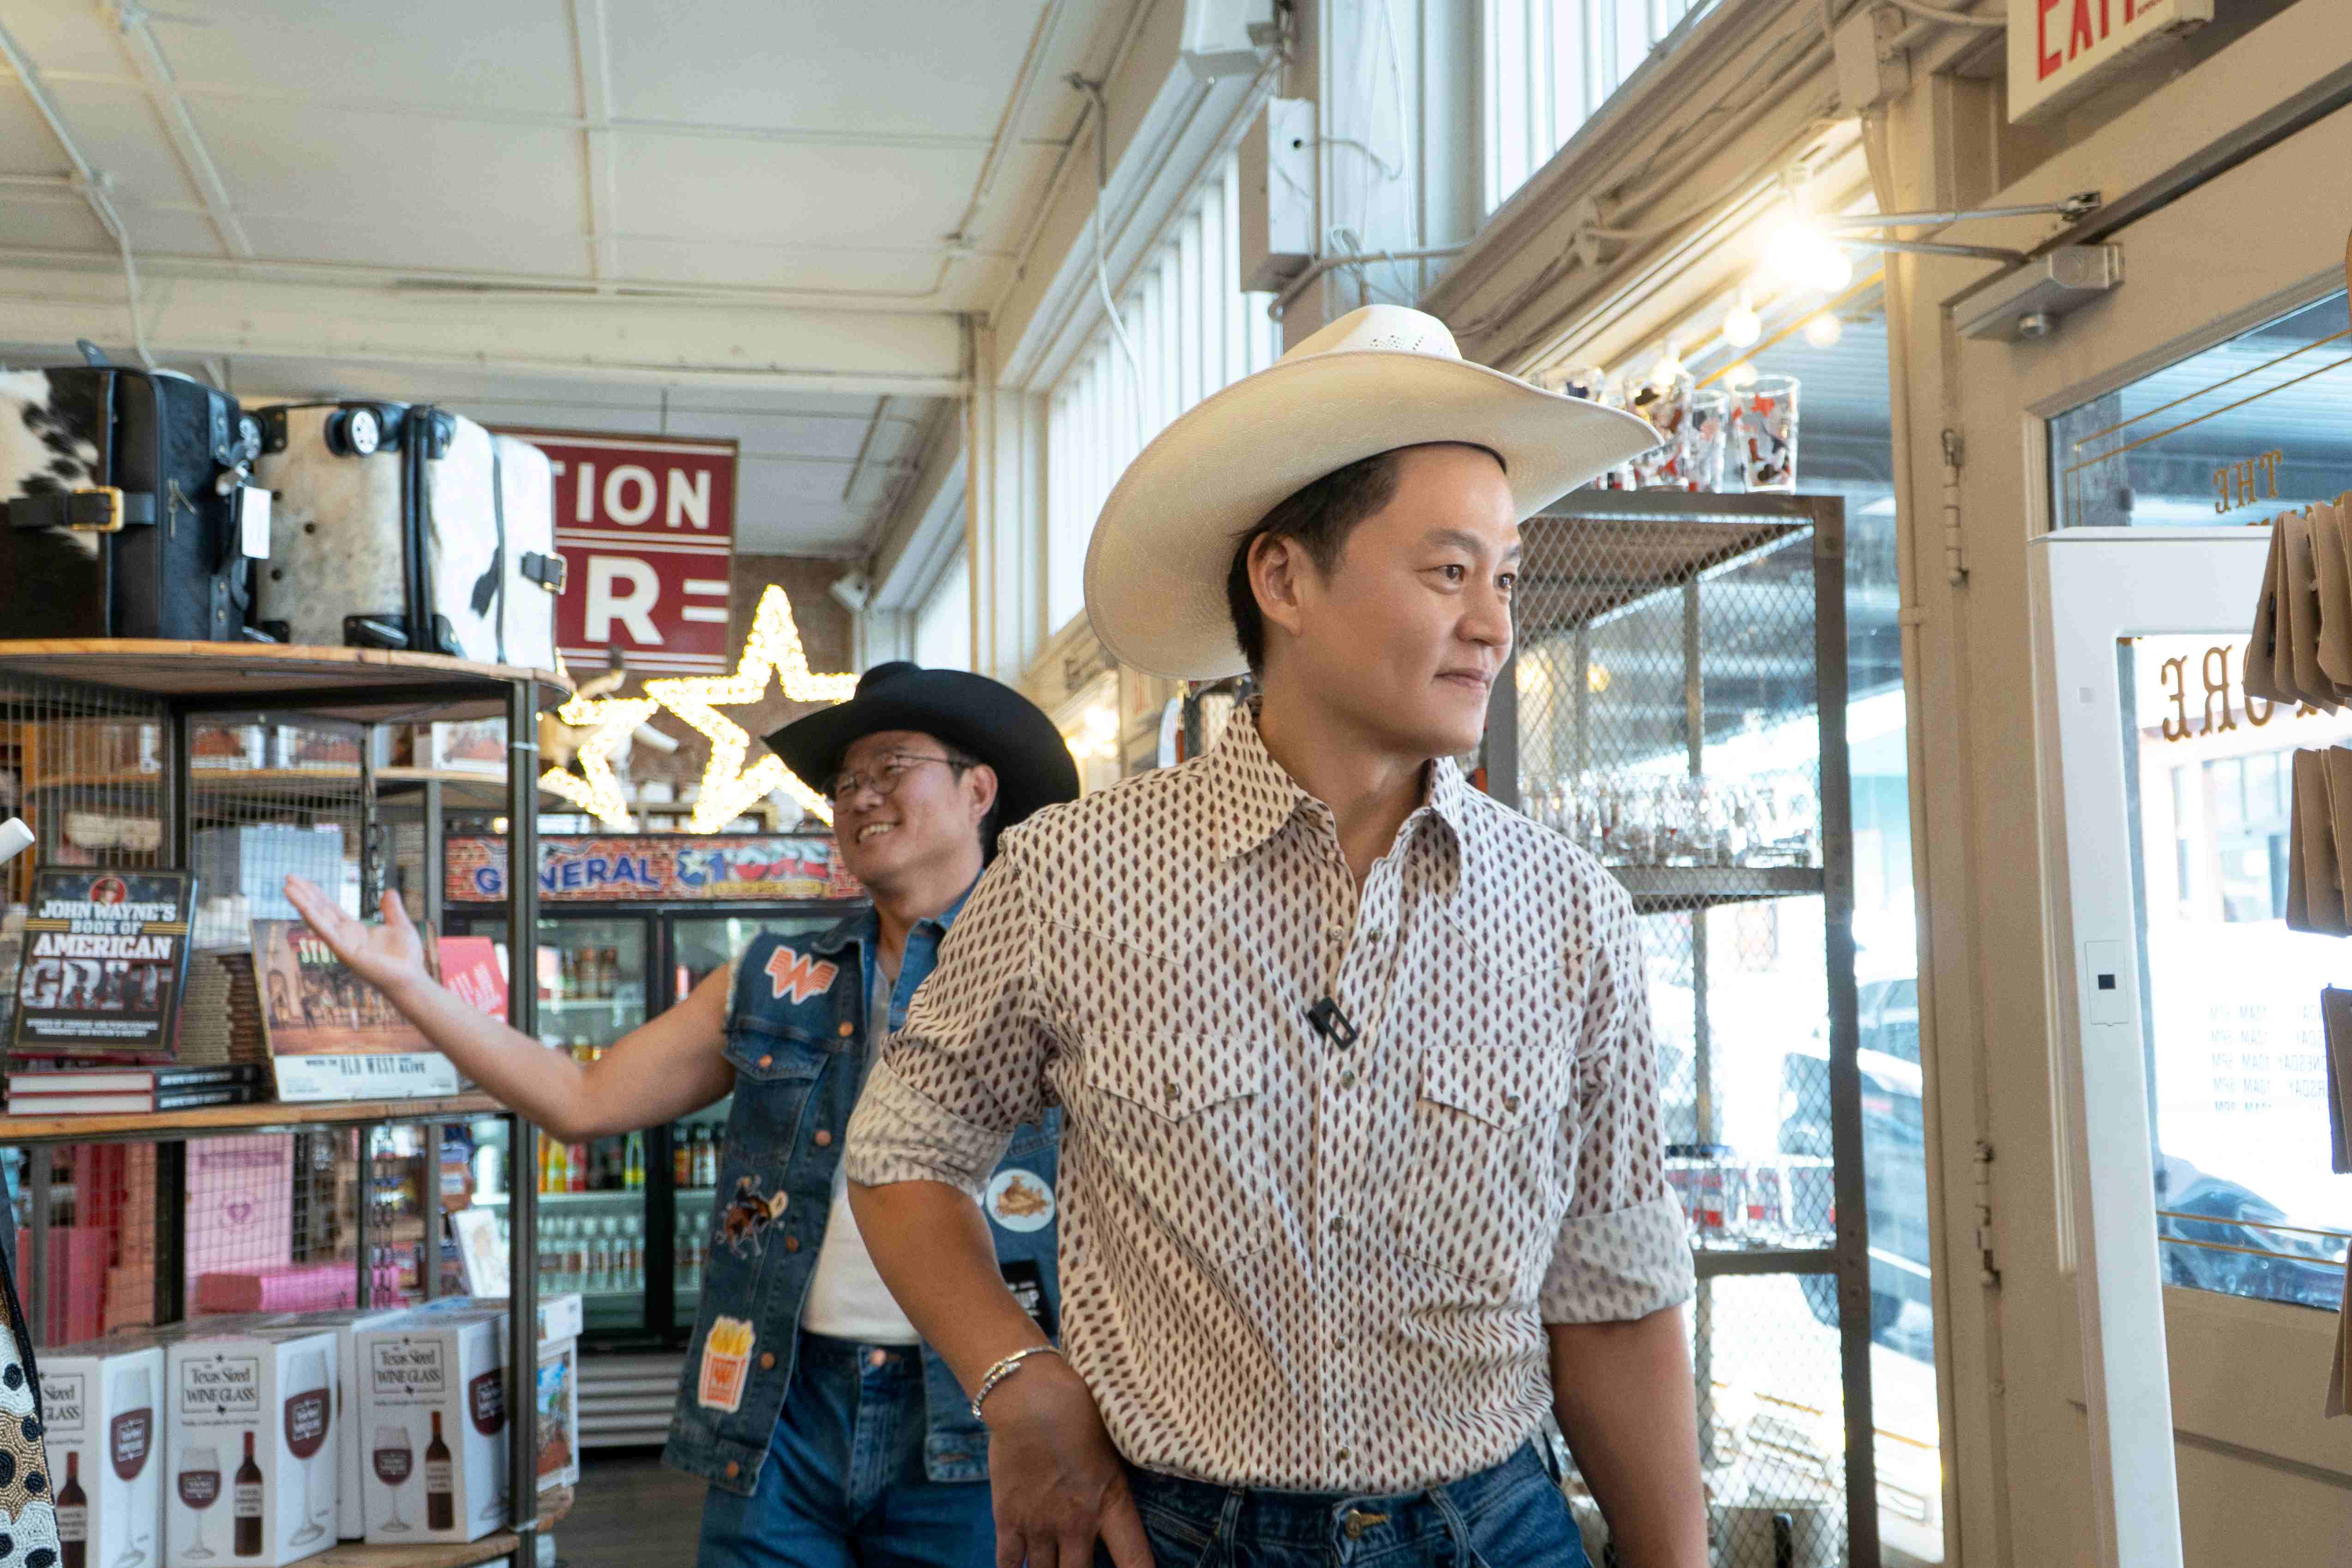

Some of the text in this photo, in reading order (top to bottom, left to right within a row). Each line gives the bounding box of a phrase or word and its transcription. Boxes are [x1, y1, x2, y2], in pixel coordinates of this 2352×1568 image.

[552, 461, 711, 529] ION
[475, 840, 829, 892] GNERAL STORE
[39, 901, 176, 921] JOHN WAYNE'S
[71, 920, 143, 935] BOOK OF
[33, 933, 173, 959] AMERICAN
[20, 959, 174, 1012] GRIT
[191, 1367, 251, 1384] Texas Sized
[376, 1368, 441, 1384] WINE GLASS
[43, 1385, 75, 1401] Sized
[186, 1387, 255, 1403] WINE GLASS
